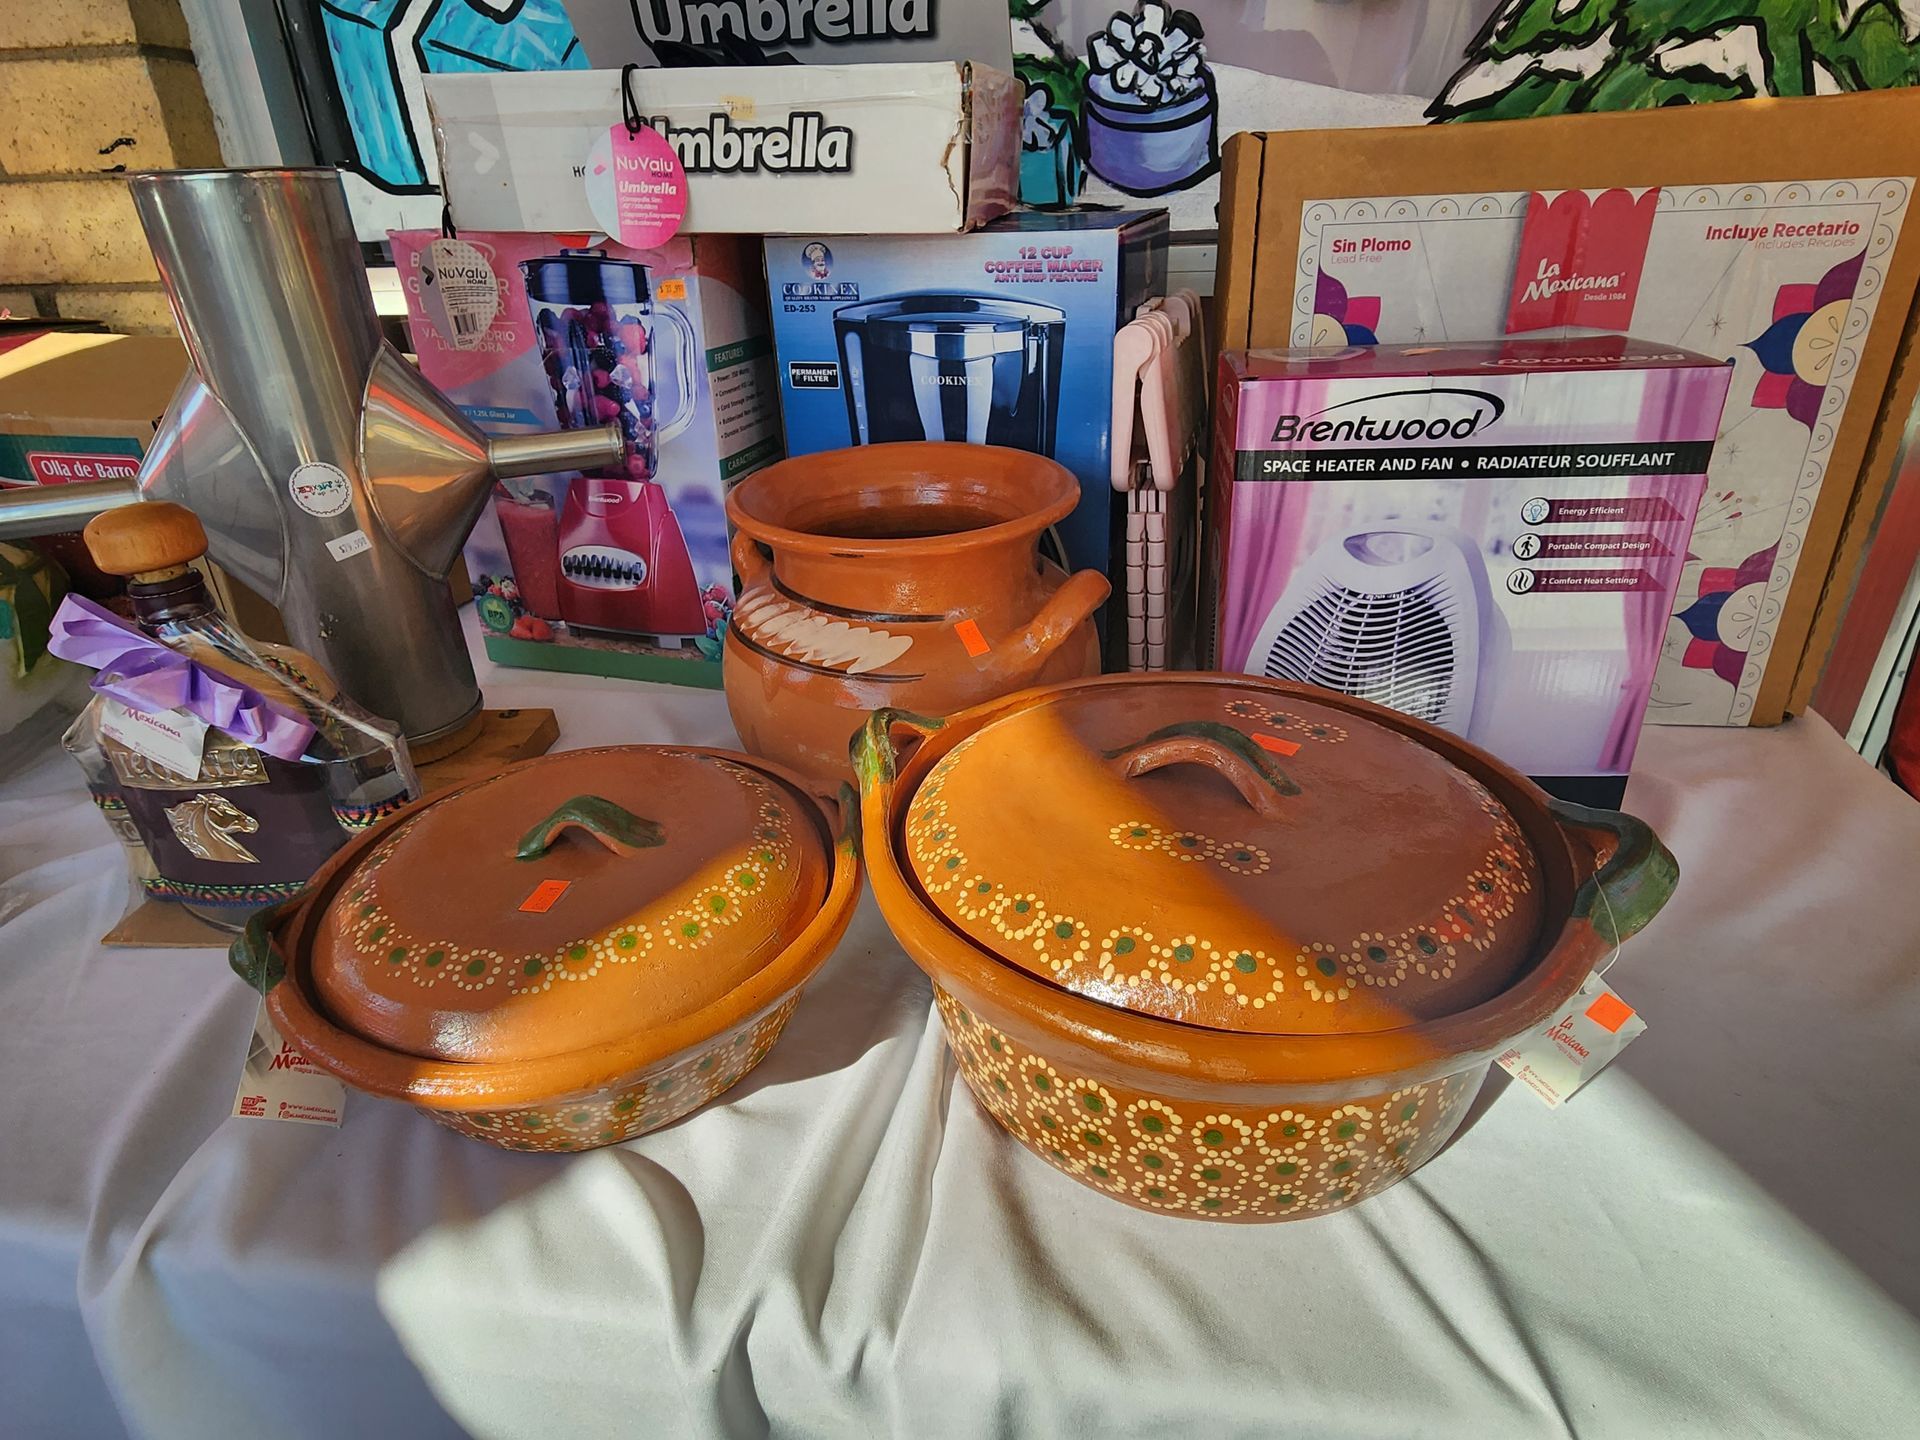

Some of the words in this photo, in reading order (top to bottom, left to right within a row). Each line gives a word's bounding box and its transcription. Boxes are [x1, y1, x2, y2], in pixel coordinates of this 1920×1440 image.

[634, 0, 933, 46] Umbrella
[616, 157, 674, 172] NuValu
[619, 181, 677, 195] Umbrella
[1705, 225, 1768, 241] Incluye
[1773, 220, 1860, 238] Recetario
[1332, 239, 1357, 253] Sin
[1361, 238, 1411, 252] Plomo
[1754, 238, 1804, 250] Includes
[1807, 237, 1856, 249] Recipes
[1019, 246, 1037, 259] 12
[1040, 246, 1073, 259] CUP
[1331, 254, 1356, 264] Lead
[1359, 254, 1382, 263] Free
[438, 267, 488, 279] NuValu
[984, 261, 1042, 273] COFFEE
[1047, 260, 1103, 272] MAKER
[1537, 258, 1560, 280] La
[994, 274, 1020, 283] ANTI
[1520, 272, 1620, 304] Mexicana
[784, 304, 816, 313] ED-253
[714, 347, 744, 364] FEATURES
[1270, 408, 1484, 442] Brentwood
[41, 460, 71, 477] Olla
[74, 461, 93, 478] de
[94, 463, 135, 479] Barro
[1263, 460, 1311, 473] SPACE
[1315, 459, 1376, 472] HEATER
[1379, 458, 1417, 471] AND
[1421, 457, 1454, 470] FAN
[1477, 455, 1572, 469] RADIATEUR
[1576, 453, 1675, 468] SOUFFLANT
[1558, 507, 1588, 516] Energy
[1590, 506, 1624, 515] Efficient
[1584, 542, 1620, 551] Compact
[1622, 541, 1650, 550] Design
[1541, 577, 1547, 585] 2
[1548, 577, 1582, 585] Comfort
[1583, 577, 1603, 585] Heat
[1604, 576, 1638, 585] Settings
[122, 706, 182, 739] Mexicana
[1559, 1014, 1574, 1031] La
[1544, 1024, 1590, 1060] Mexicana
